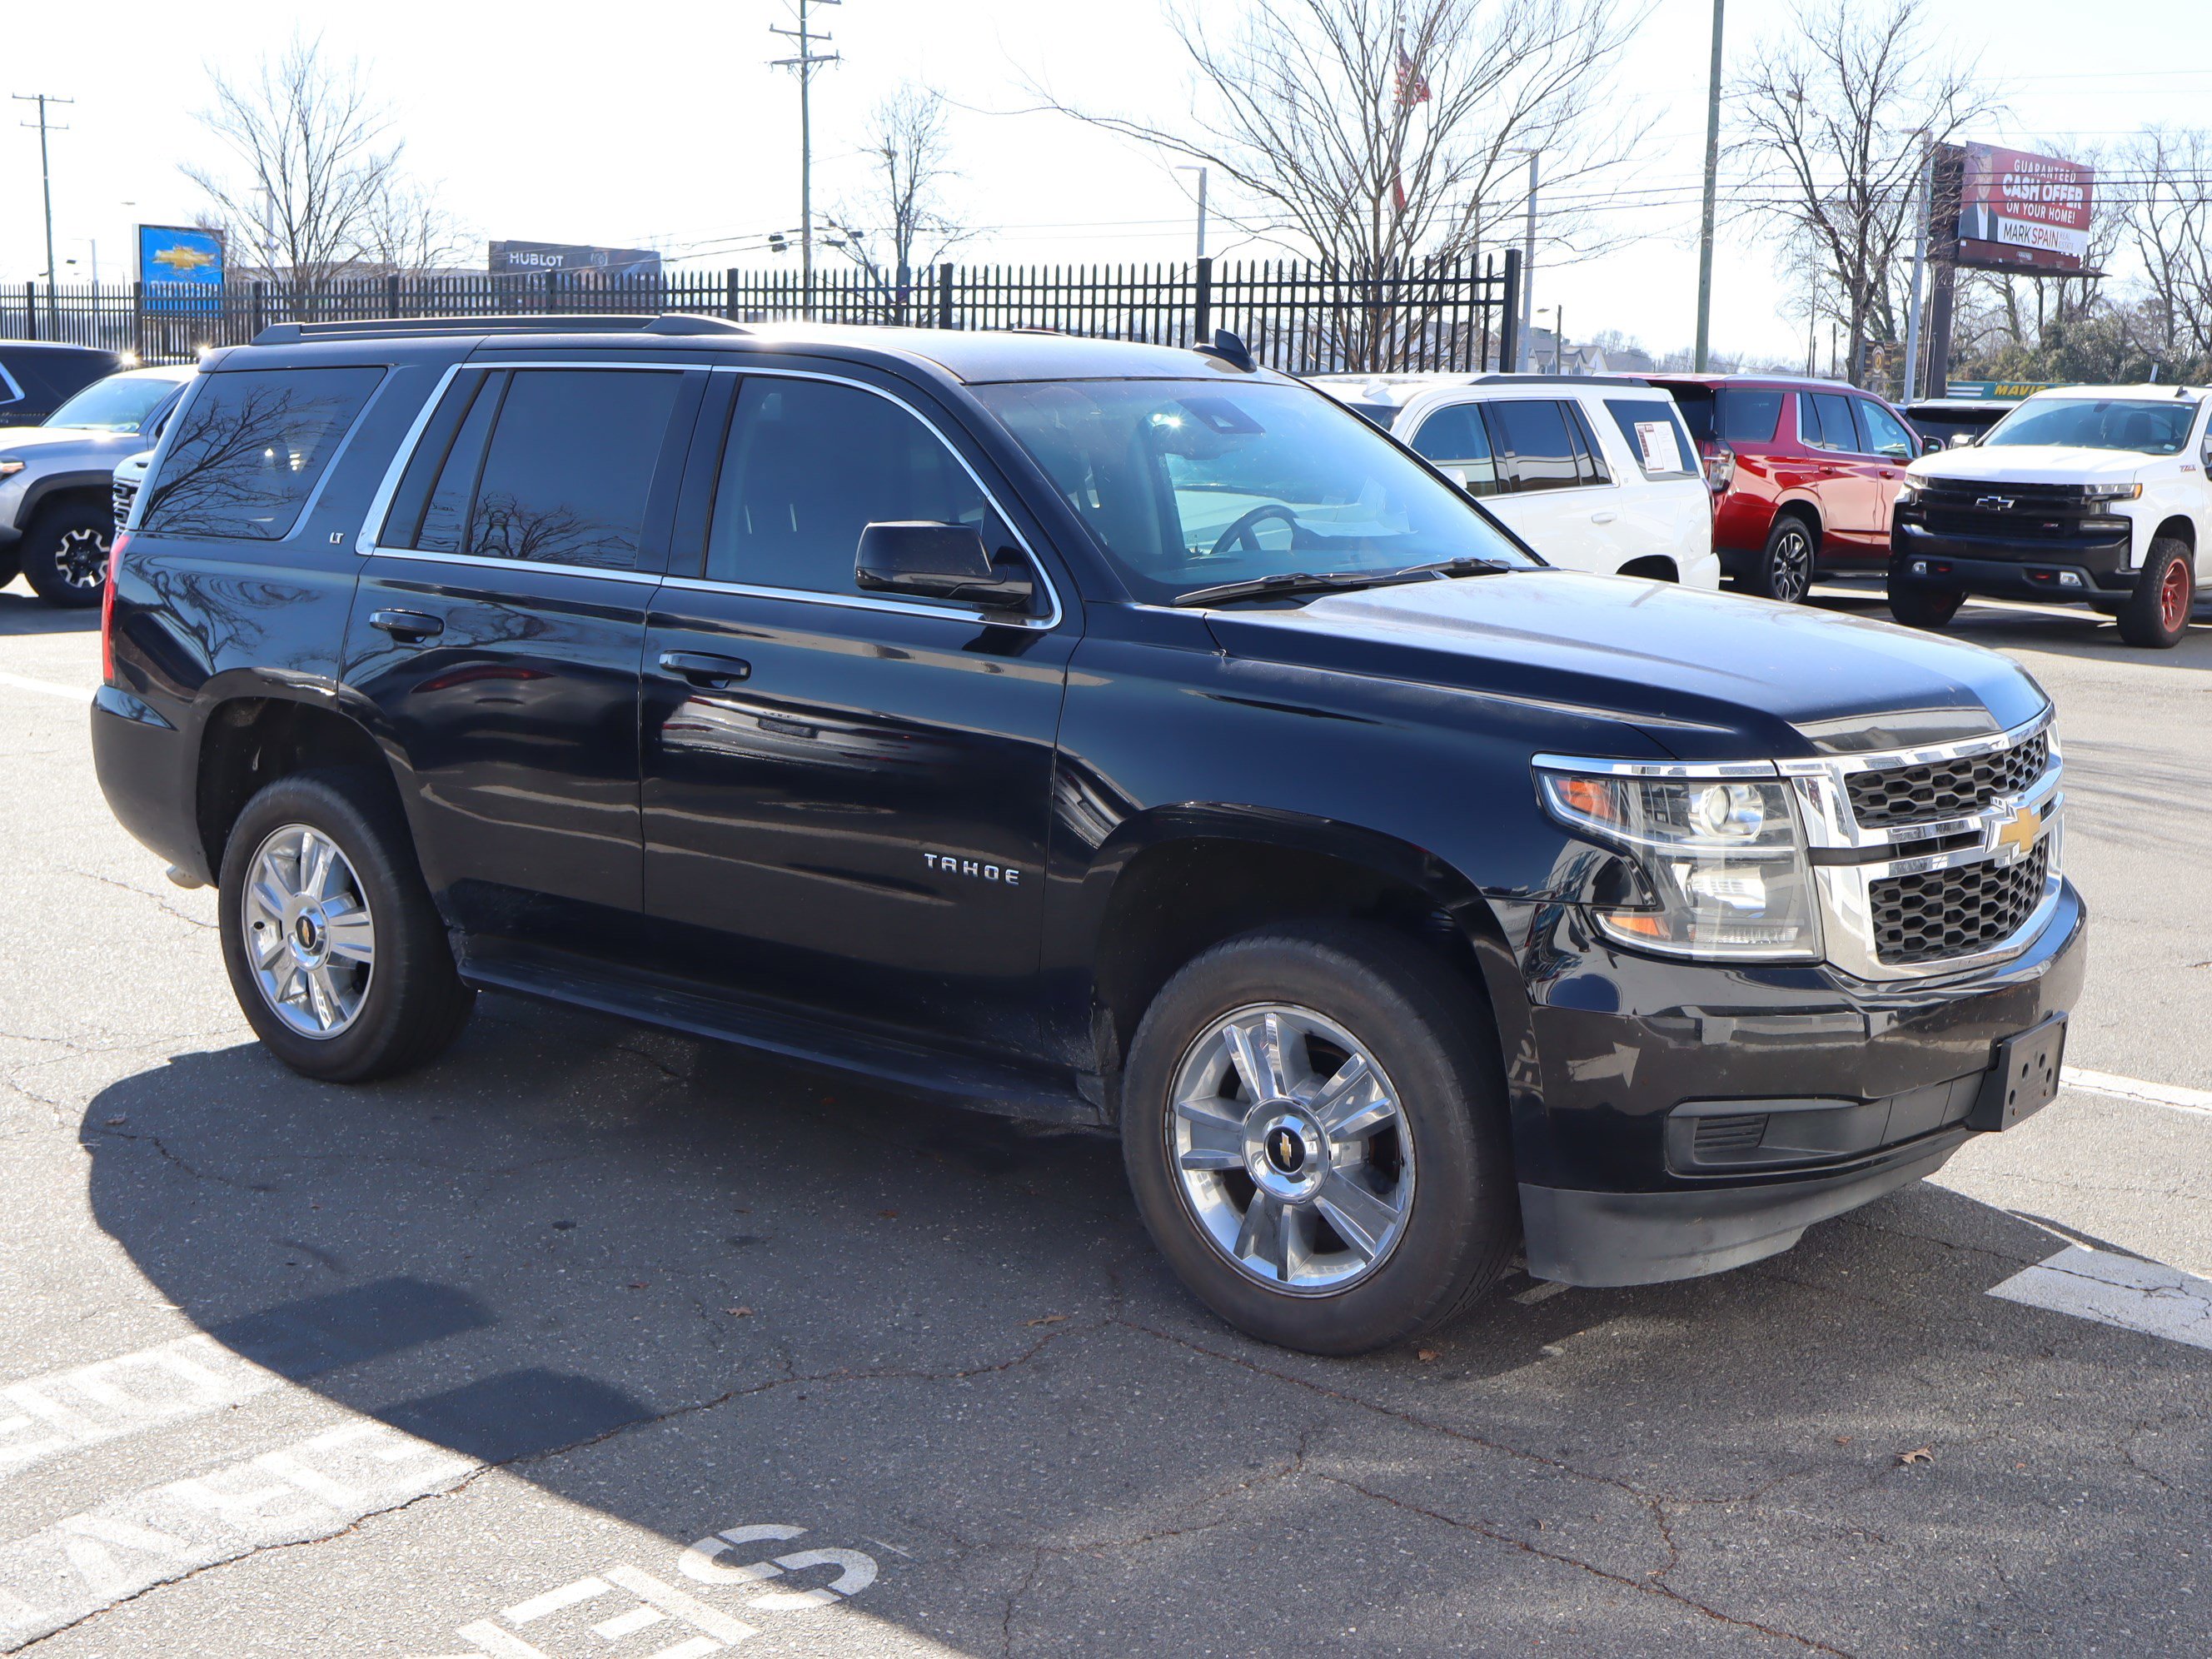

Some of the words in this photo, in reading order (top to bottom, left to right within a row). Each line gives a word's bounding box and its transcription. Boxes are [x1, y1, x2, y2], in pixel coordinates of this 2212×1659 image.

[2014, 159, 2076, 184] GUARANTEED
[2002, 173, 2040, 202] CASH
[2042, 181, 2084, 210] OFFER
[2006, 199, 2020, 215] ON
[2023, 202, 2046, 219] YOUR
[2049, 207, 2076, 225] HOME!
[2003, 222, 2031, 243] MARK
[2031, 227, 2059, 249] SPAIN
[510, 252, 564, 267] HUBLOT
[329, 531, 344, 545] LT
[924, 853, 1003, 886] TAHOE
